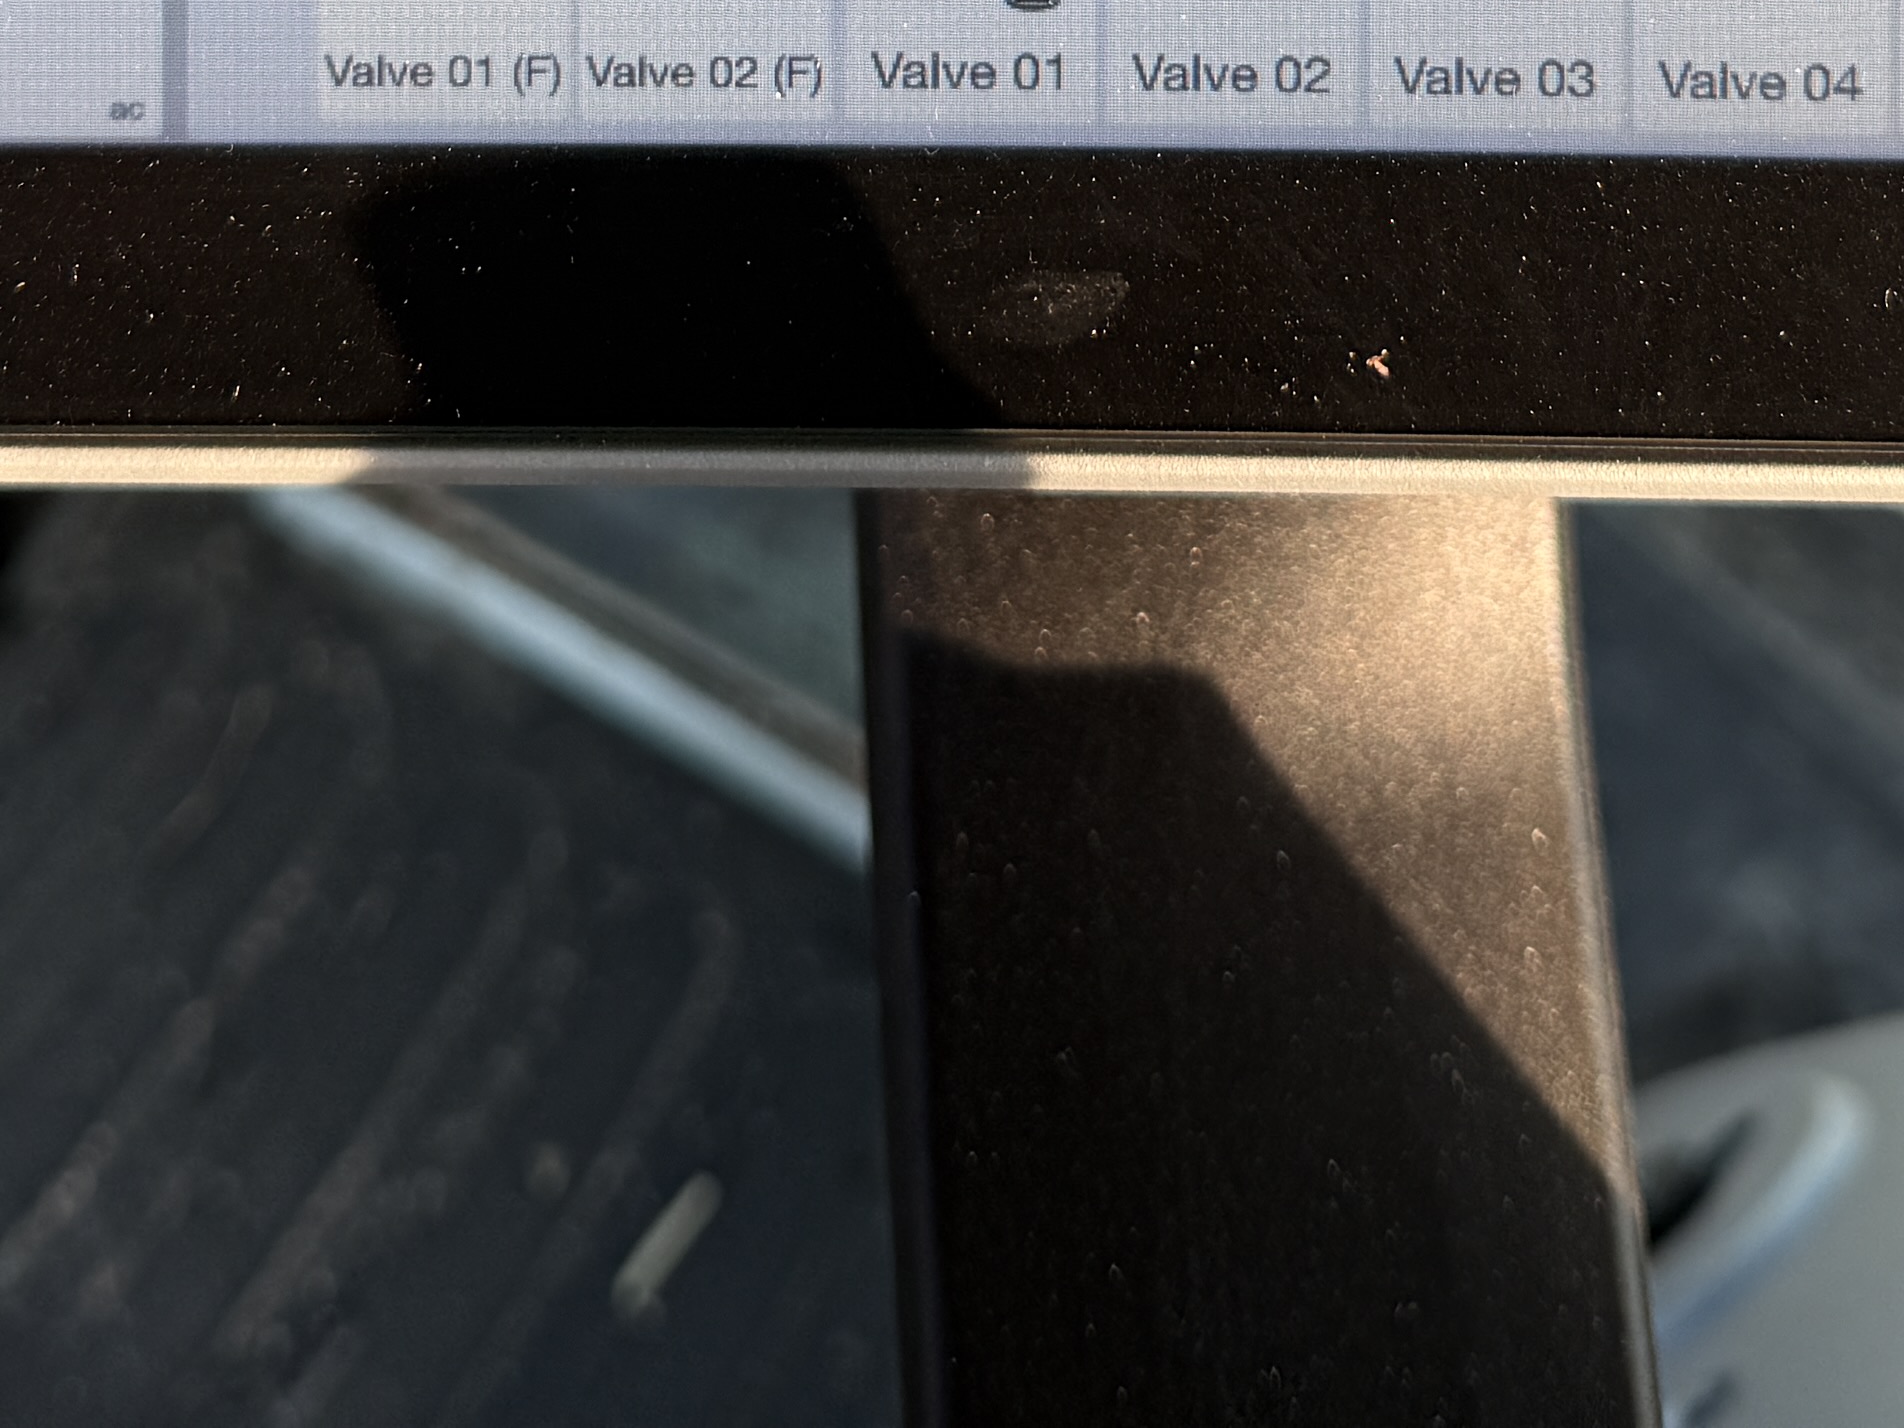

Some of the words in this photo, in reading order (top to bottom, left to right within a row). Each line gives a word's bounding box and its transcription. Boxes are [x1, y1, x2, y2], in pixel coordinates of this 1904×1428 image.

[326, 53, 436, 91] Valve
[448, 55, 494, 90] 01
[514, 54, 561, 96] (F)
[587, 54, 697, 92] Valve
[709, 55, 761, 91] 02
[773, 55, 822, 97] (F)
[872, 52, 999, 93] Valve
[1012, 55, 1064, 93] 01
[1132, 53, 1260, 95] Valve
[1274, 56, 1331, 95] 02
[1394, 55, 1522, 97] Valve
[1536, 59, 1597, 99] 03
[1659, 59, 1788, 101] Valve
[1802, 62, 1863, 102] 04
[109, 101, 146, 121] ac
